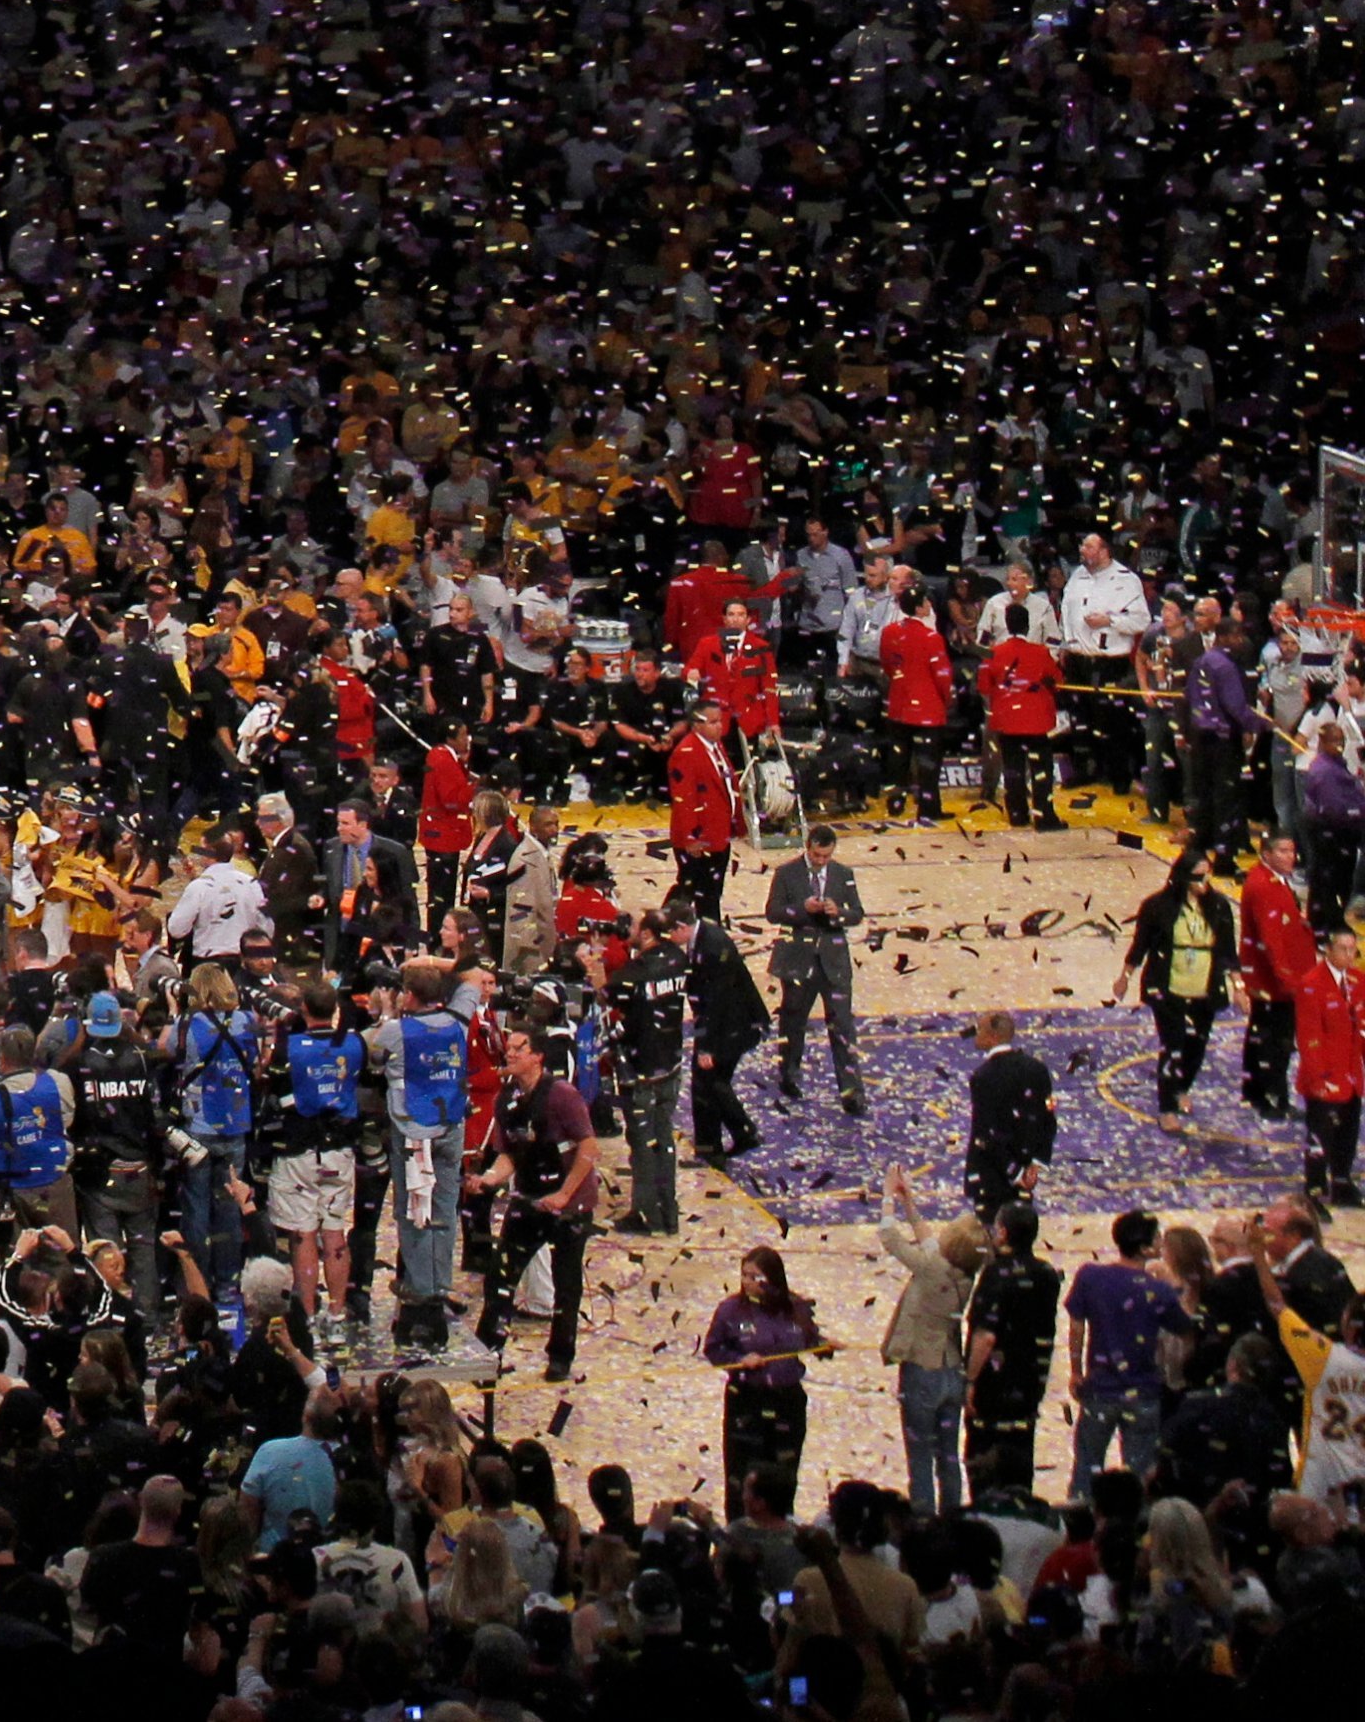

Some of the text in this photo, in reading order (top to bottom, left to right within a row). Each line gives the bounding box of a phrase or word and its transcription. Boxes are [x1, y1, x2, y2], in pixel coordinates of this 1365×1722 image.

[656, 975, 687, 996] NBA TV
[99, 1079, 147, 1098] NBA TV
